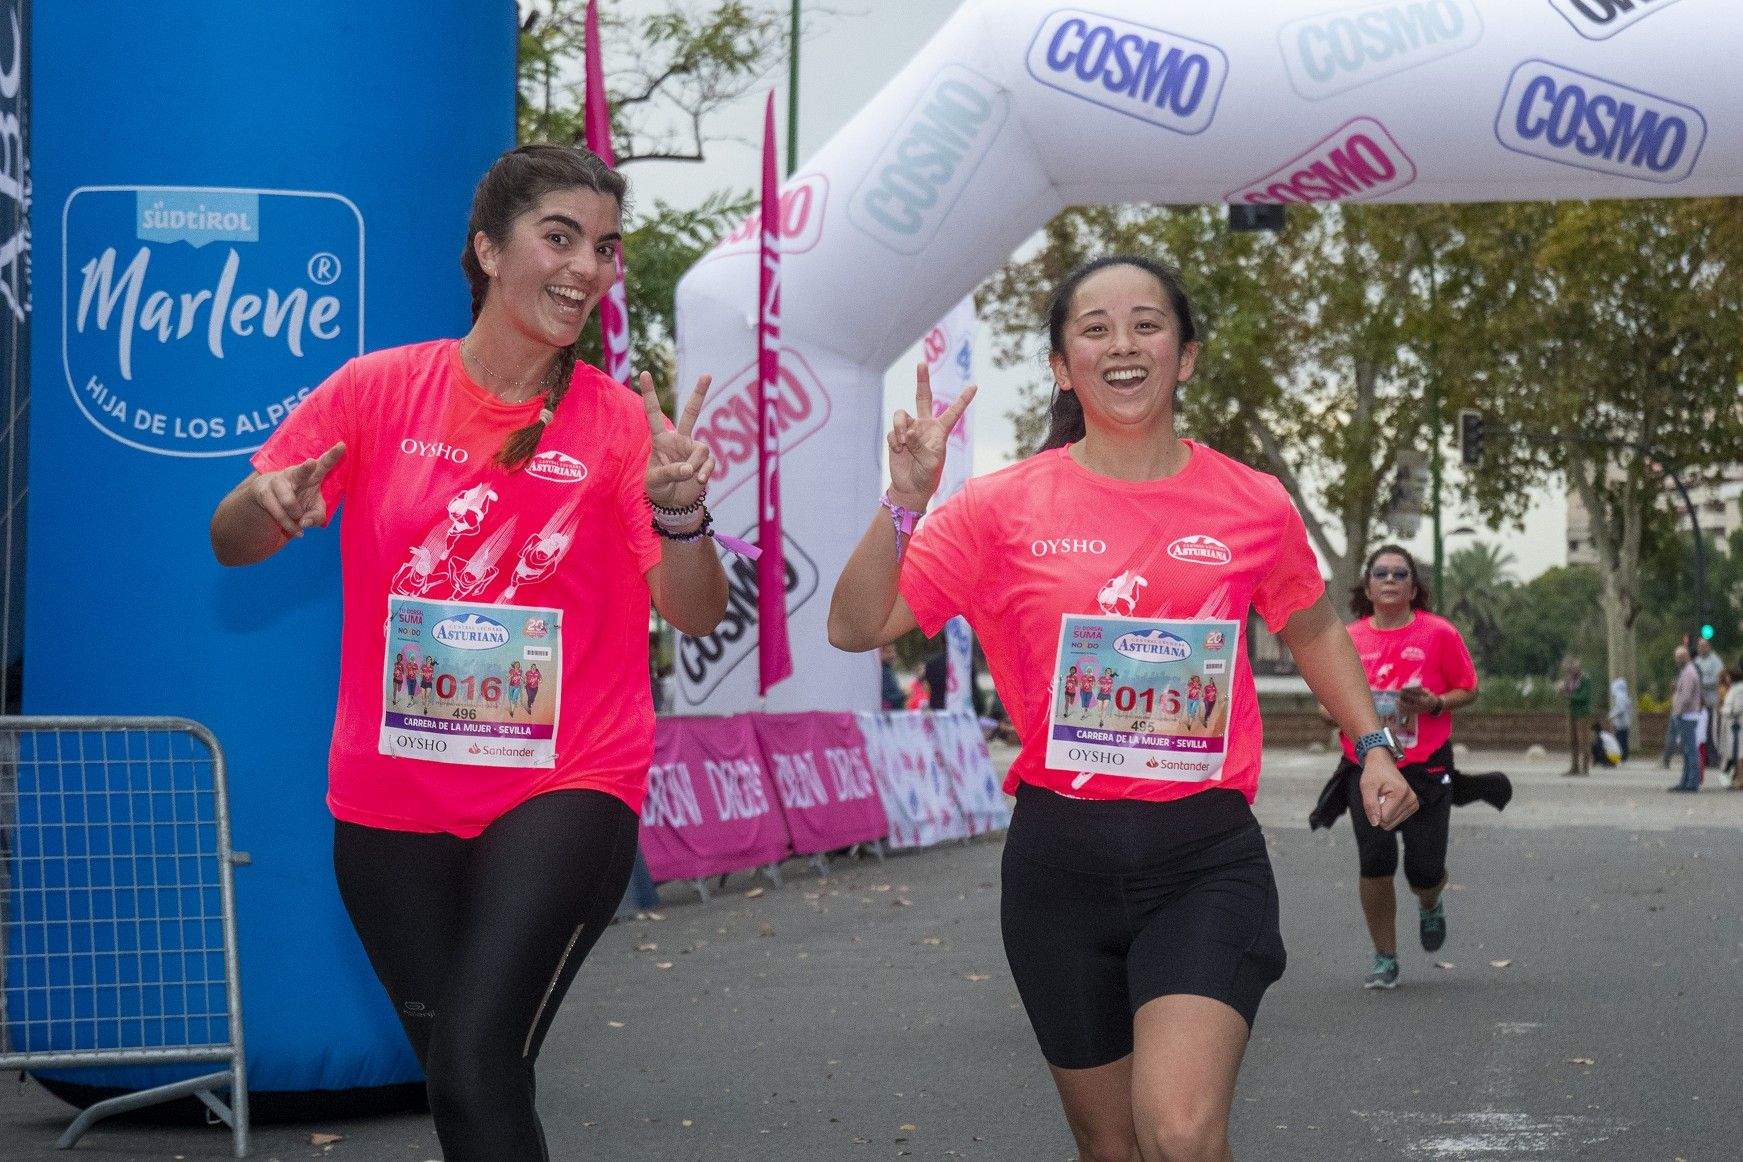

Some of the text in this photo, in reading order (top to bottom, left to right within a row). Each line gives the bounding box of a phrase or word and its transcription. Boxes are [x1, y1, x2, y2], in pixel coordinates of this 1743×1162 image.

[1299, 0, 1465, 82] COSMO
[1047, 18, 1209, 117] COSMO
[1516, 75, 1687, 172] COSMO
[865, 81, 991, 235] COSMO
[1244, 134, 1396, 202] SMO
[77, 247, 341, 381] Marlene
[86, 375, 127, 422] HIJA
[134, 408, 167, 435] DE
[175, 417, 226, 439] LOS
[694, 366, 812, 481] OSMO
[401, 438, 469, 463] OYSHO
[530, 460, 582, 478] ASTURIANA
[1031, 538, 1107, 557] OYSHO
[1172, 544, 1228, 562] ASTURIANA
[399, 613, 423, 624] SUMA
[437, 624, 504, 642] ASTURIANA
[1073, 631, 1102, 639] SUMA
[1117, 638, 1186, 658] ASTURIANA
[436, 674, 502, 701] 016
[1115, 686, 1181, 715] 016
[452, 708, 476, 720] 496
[403, 717, 437, 729] CARRERA
[439, 722, 448, 731] DE
[451, 723, 461, 731] LA
[463, 723, 491, 733] MUJER
[499, 725, 532, 736] SEVILLA
[397, 735, 535, 757] OYSHO Santander
[1076, 730, 1114, 741] CARRERA
[1116, 734, 1126, 743] DE
[1129, 735, 1139, 744] LA
[1141, 736, 1169, 746] MUJER
[1176, 739, 1207, 749] SEVILLA
[1068, 748, 1210, 771] OYSHO Santander
